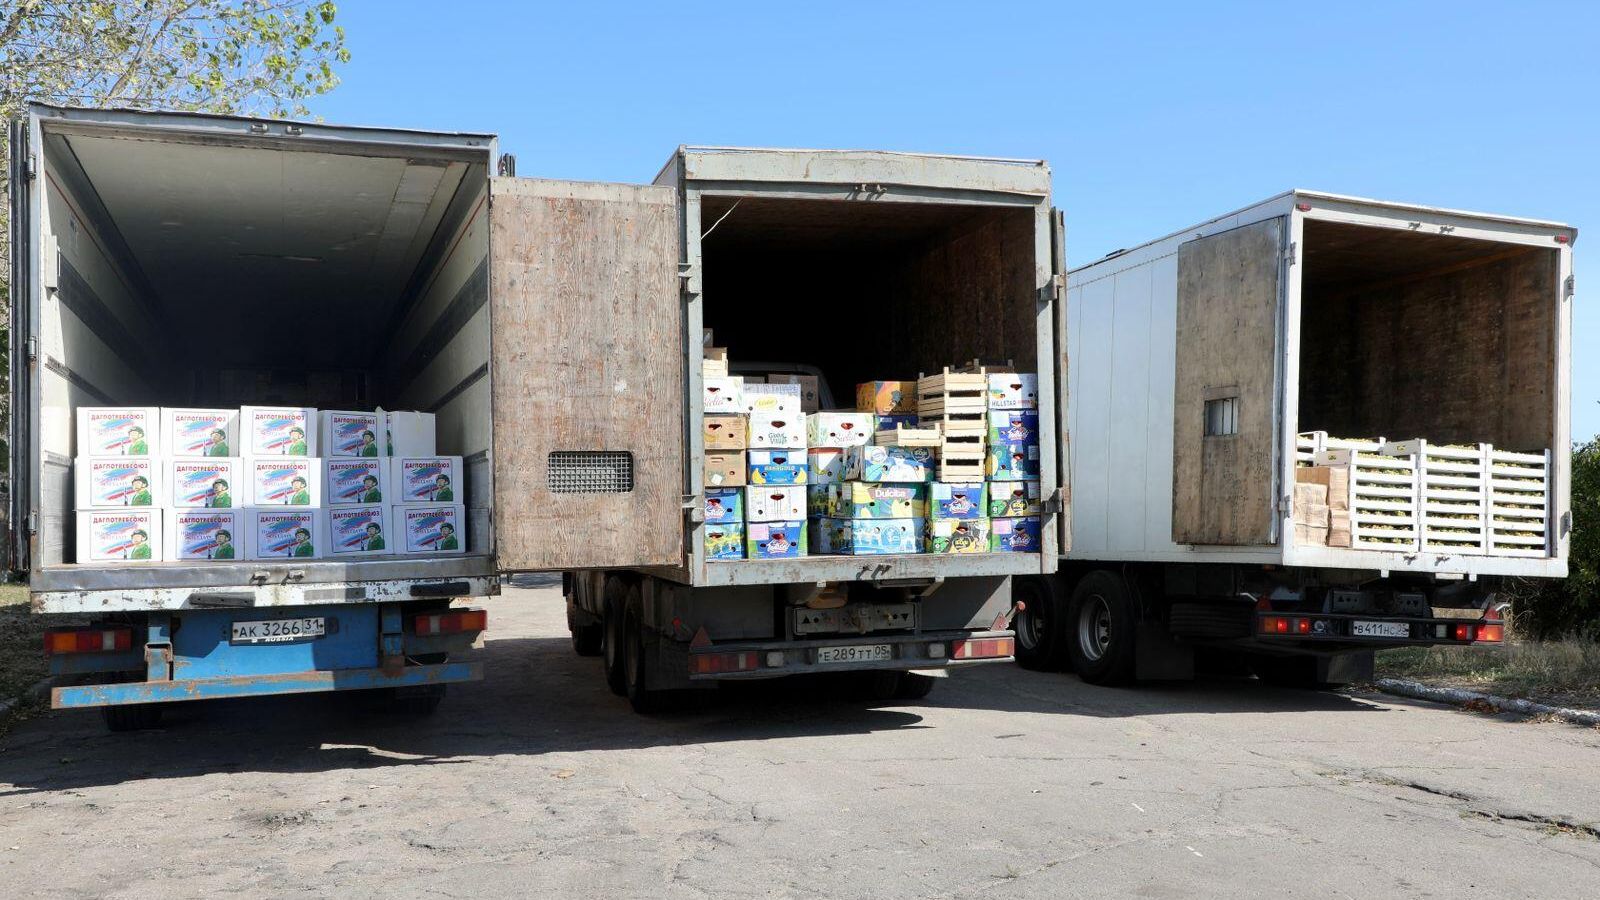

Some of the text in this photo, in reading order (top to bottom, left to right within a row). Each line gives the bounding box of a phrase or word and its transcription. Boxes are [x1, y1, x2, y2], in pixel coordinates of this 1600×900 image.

[332, 510, 379, 518] ДАГПОТРЕБСОЮЗ
[262, 622, 300, 636] 3266
[304, 619, 320, 630] 31
[874, 645, 887, 655] 05
